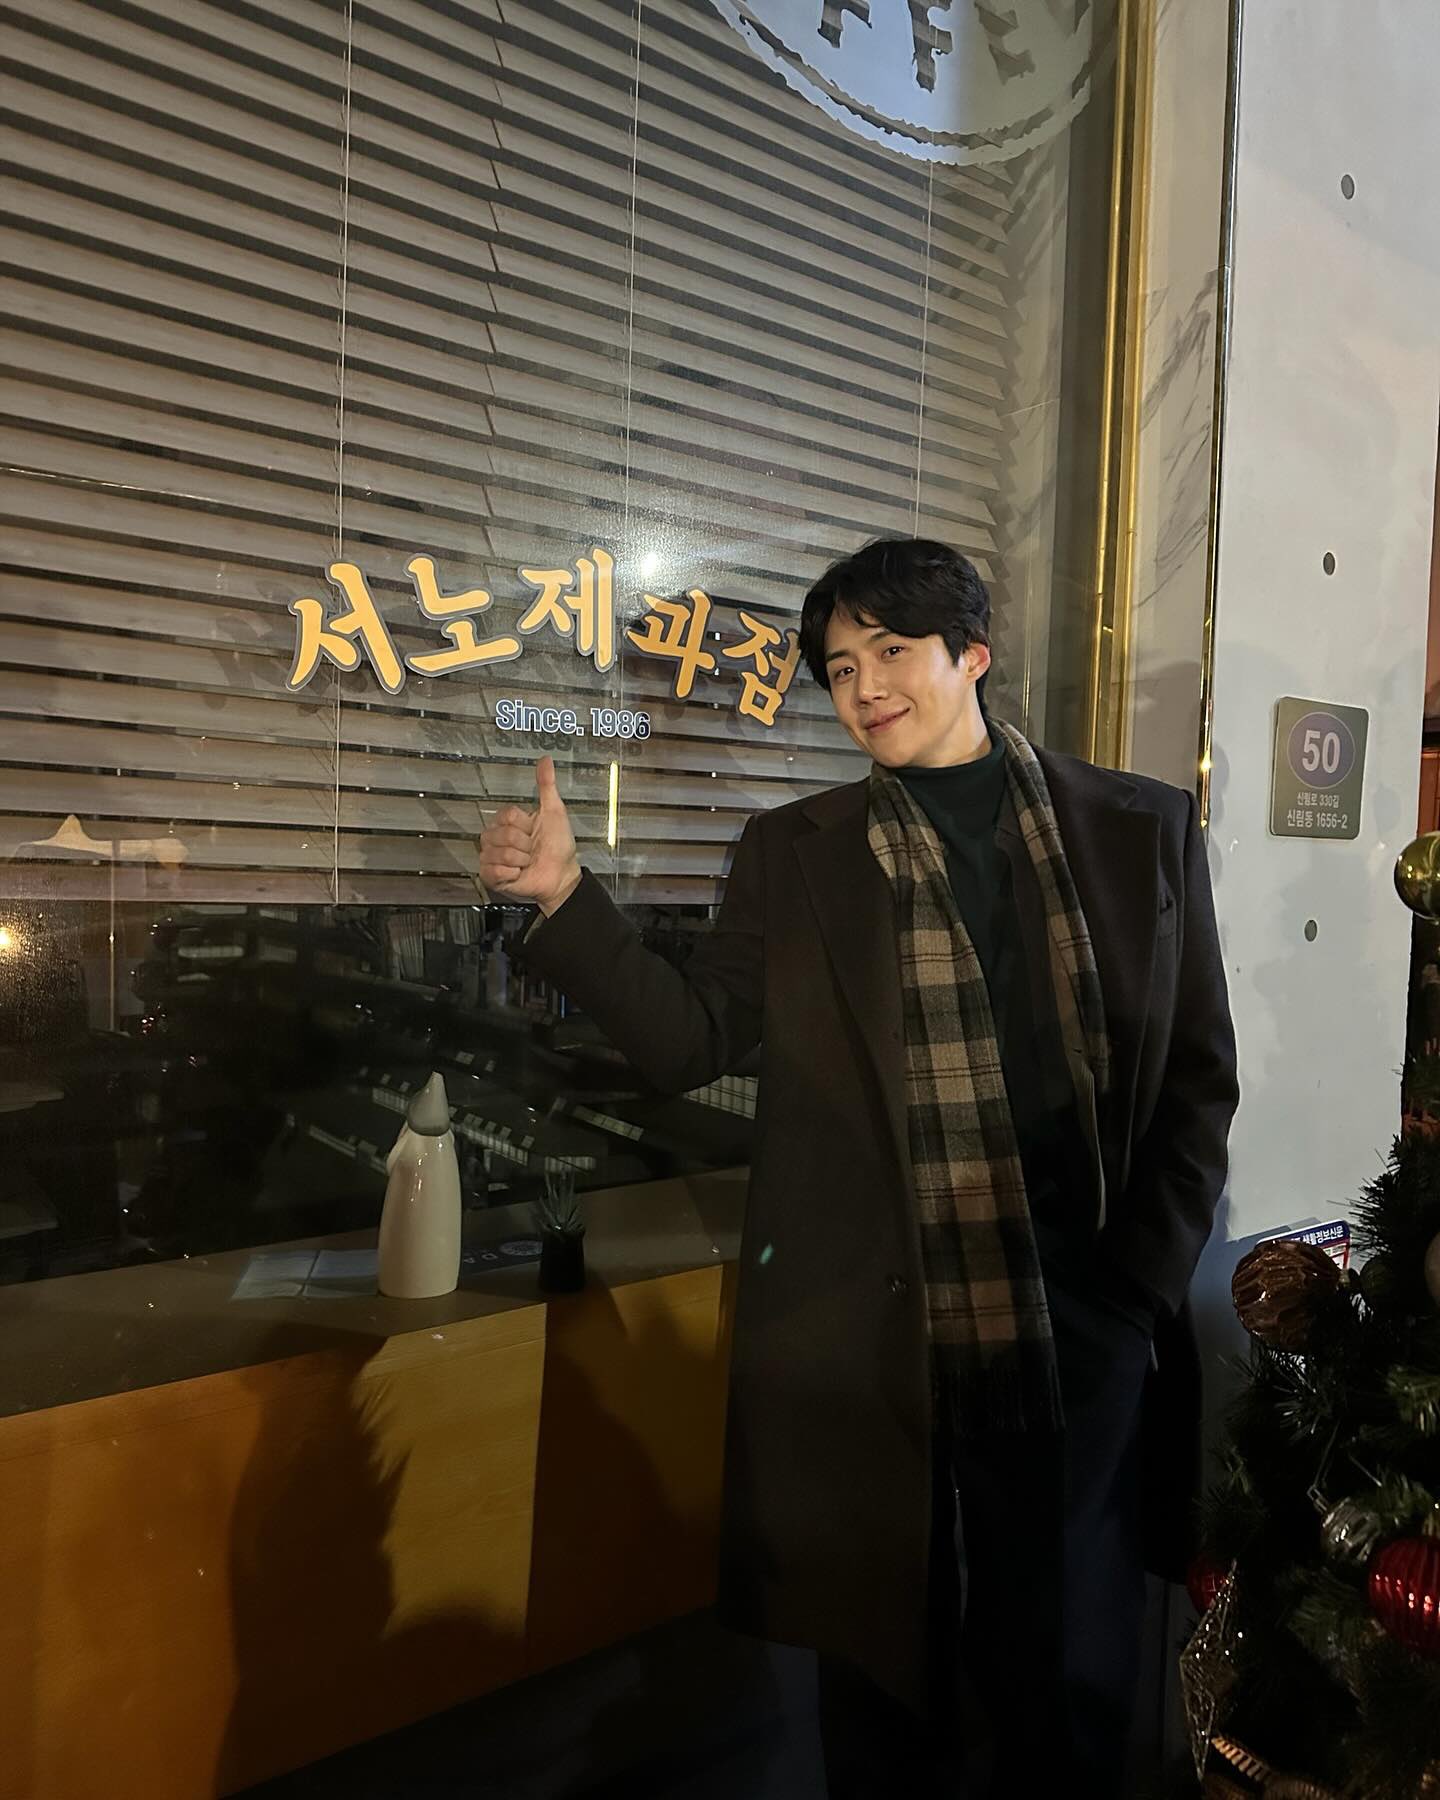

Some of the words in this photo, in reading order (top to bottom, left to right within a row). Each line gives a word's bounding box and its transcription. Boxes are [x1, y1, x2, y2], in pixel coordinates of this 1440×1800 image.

[287, 547, 800, 728] 서노제과점
[496, 699, 585, 737] Since.
[590, 707, 650, 740] 1986
[1301, 729, 1341, 774] 50
[1287, 808, 1314, 828] 신림동
[1316, 812, 1348, 830] 1656-2
